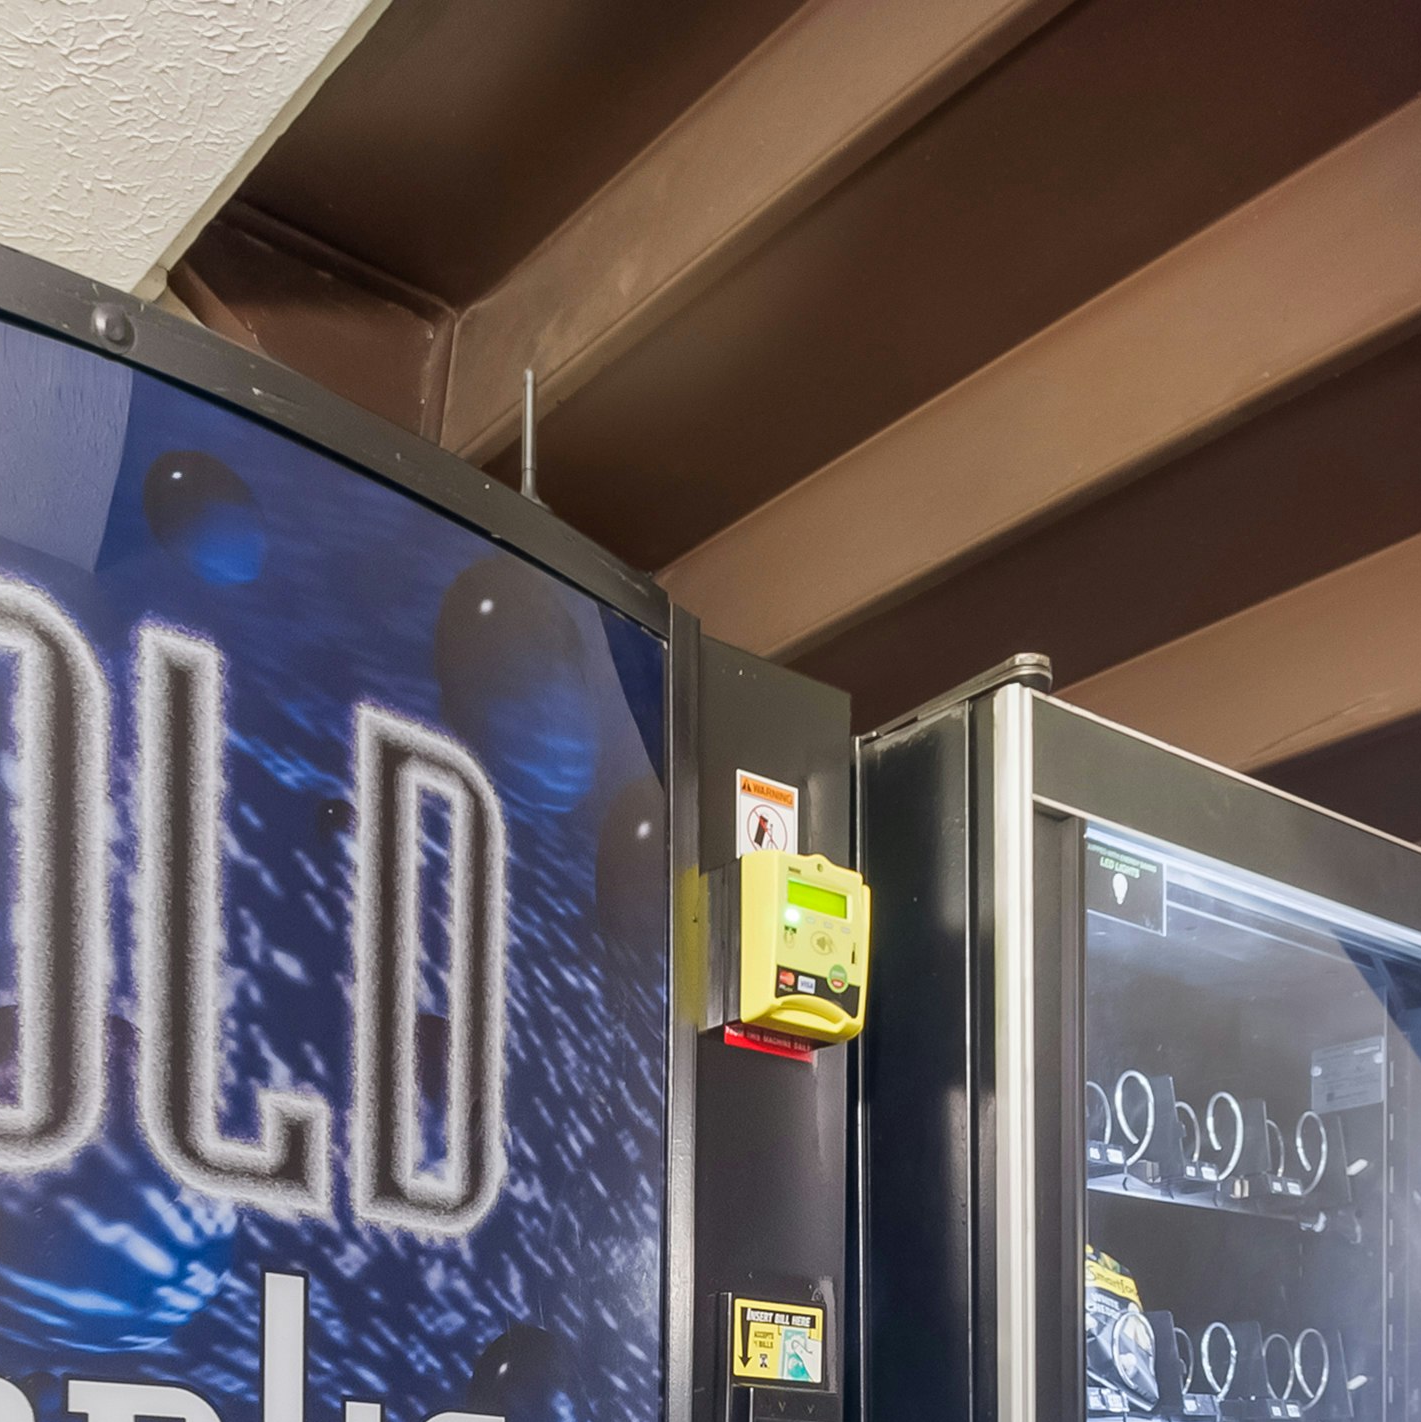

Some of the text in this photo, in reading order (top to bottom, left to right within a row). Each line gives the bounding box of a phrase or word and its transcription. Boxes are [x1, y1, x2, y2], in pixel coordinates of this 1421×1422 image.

[753, 783, 793, 805] WARNING
[746, 1307, 811, 1328] INSERT BILL HERE
